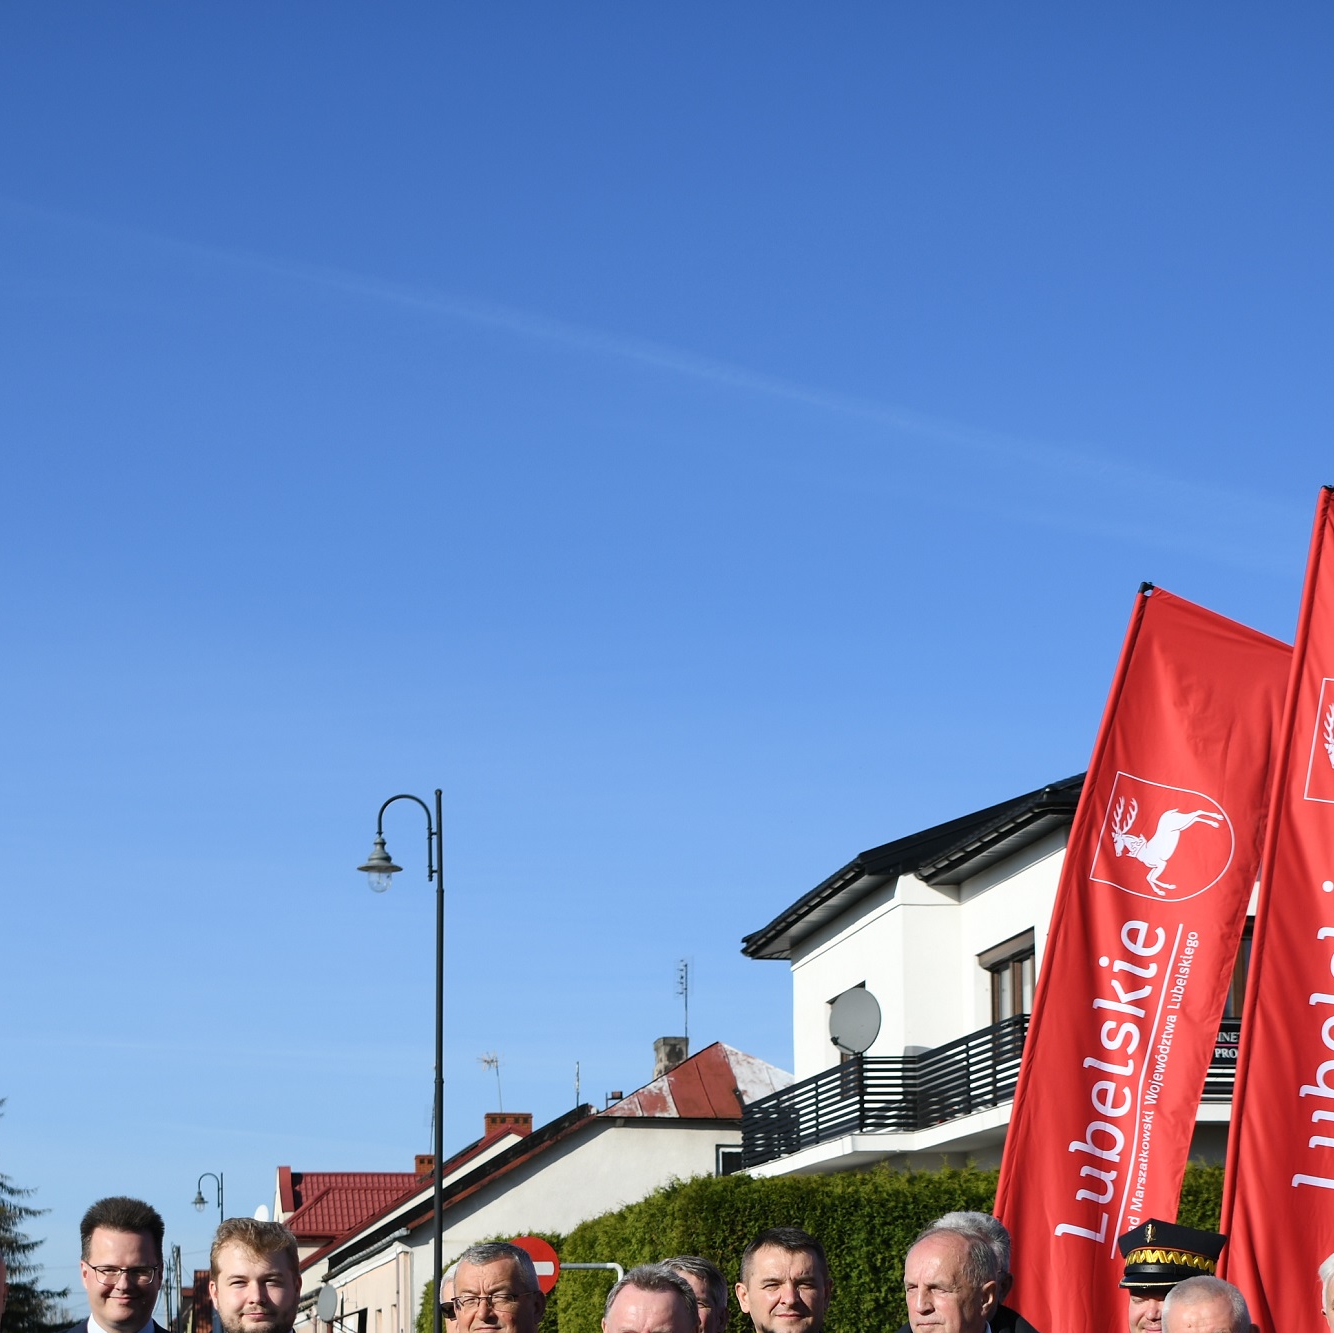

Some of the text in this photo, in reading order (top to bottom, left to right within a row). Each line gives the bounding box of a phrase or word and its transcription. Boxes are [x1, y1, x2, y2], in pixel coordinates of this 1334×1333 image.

[1054, 919, 1166, 1245] Lubelskie
[1130, 1109, 1154, 1212] Marszałkowski
[1145, 1013, 1177, 1105] Województwa
[1168, 930, 1199, 1010] Lubelskiego
